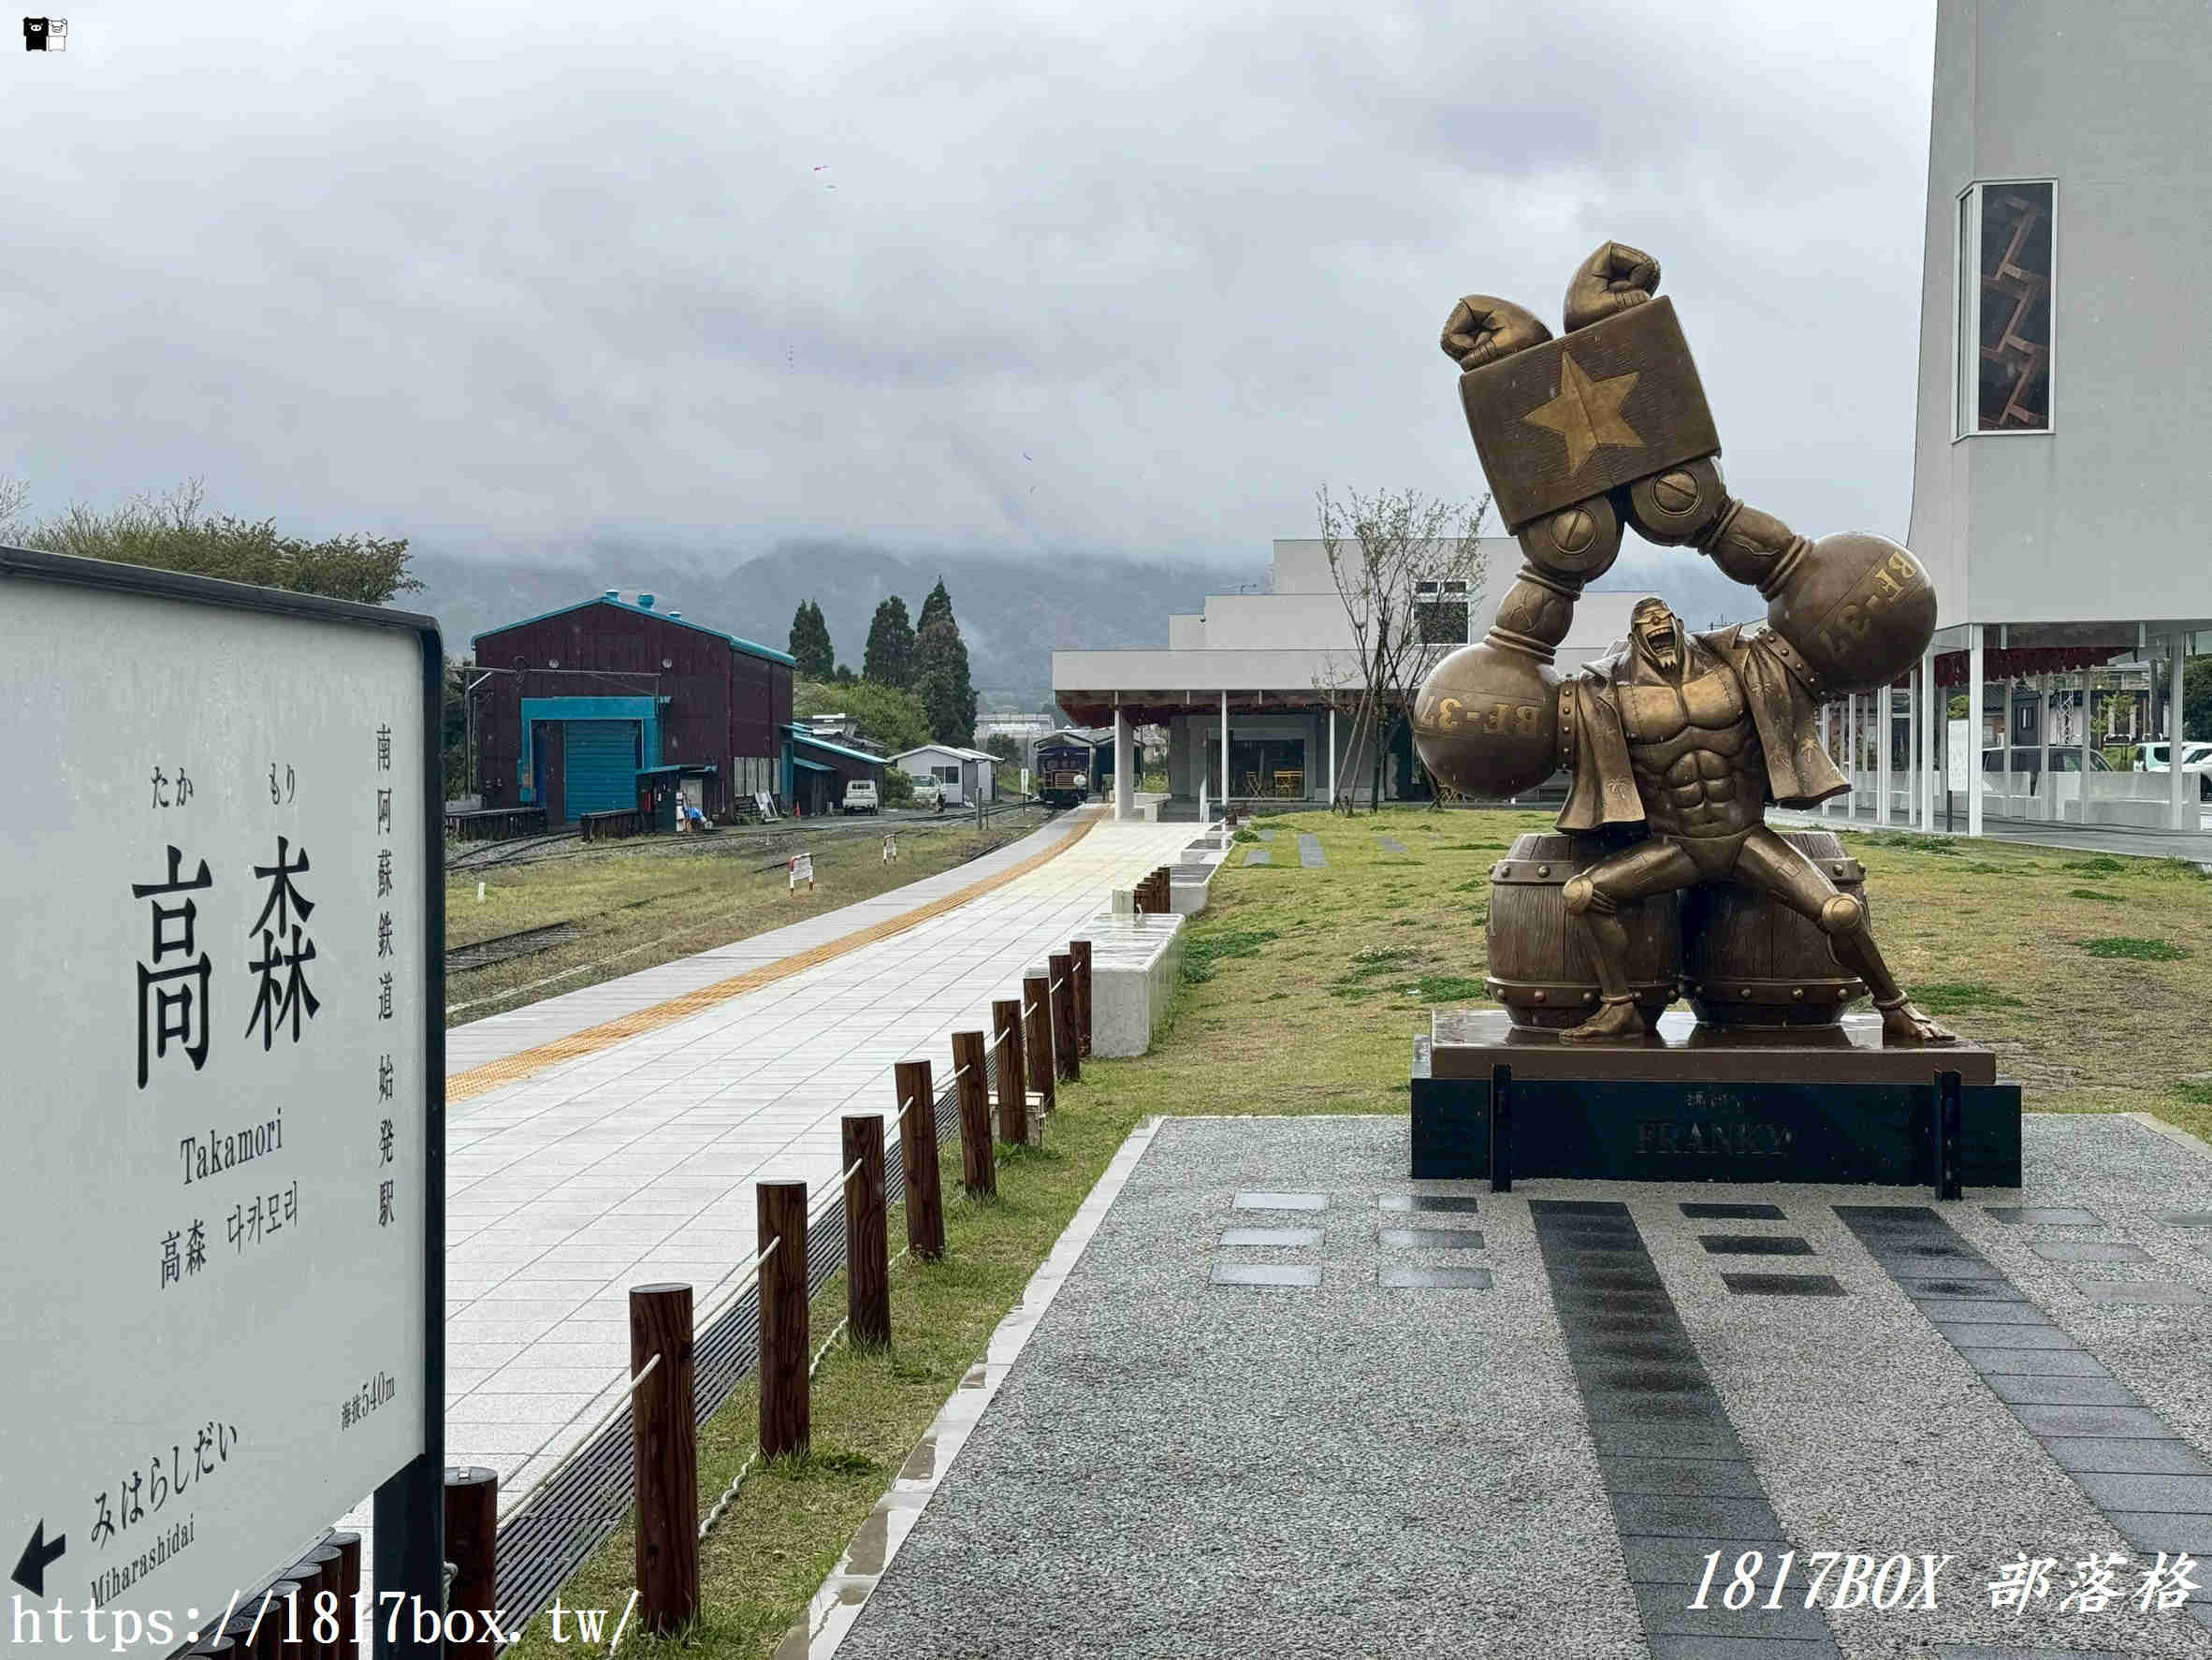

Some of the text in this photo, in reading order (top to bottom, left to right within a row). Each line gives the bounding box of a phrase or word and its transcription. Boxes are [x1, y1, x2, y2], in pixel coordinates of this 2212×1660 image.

[1420, 695, 1542, 734] BF-37
[151, 763, 296, 808] たか もり
[131, 836, 321, 1088] 高森
[181, 1106, 283, 1186] Takamori
[378, 1054, 394, 1228] 始発駅
[1635, 1121, 1793, 1154] FRANKY
[160, 1180, 298, 1290] 高森 다카모리
[91, 1420, 237, 1550] みはらしだい
[90, 1511, 195, 1610] Miharashidai
